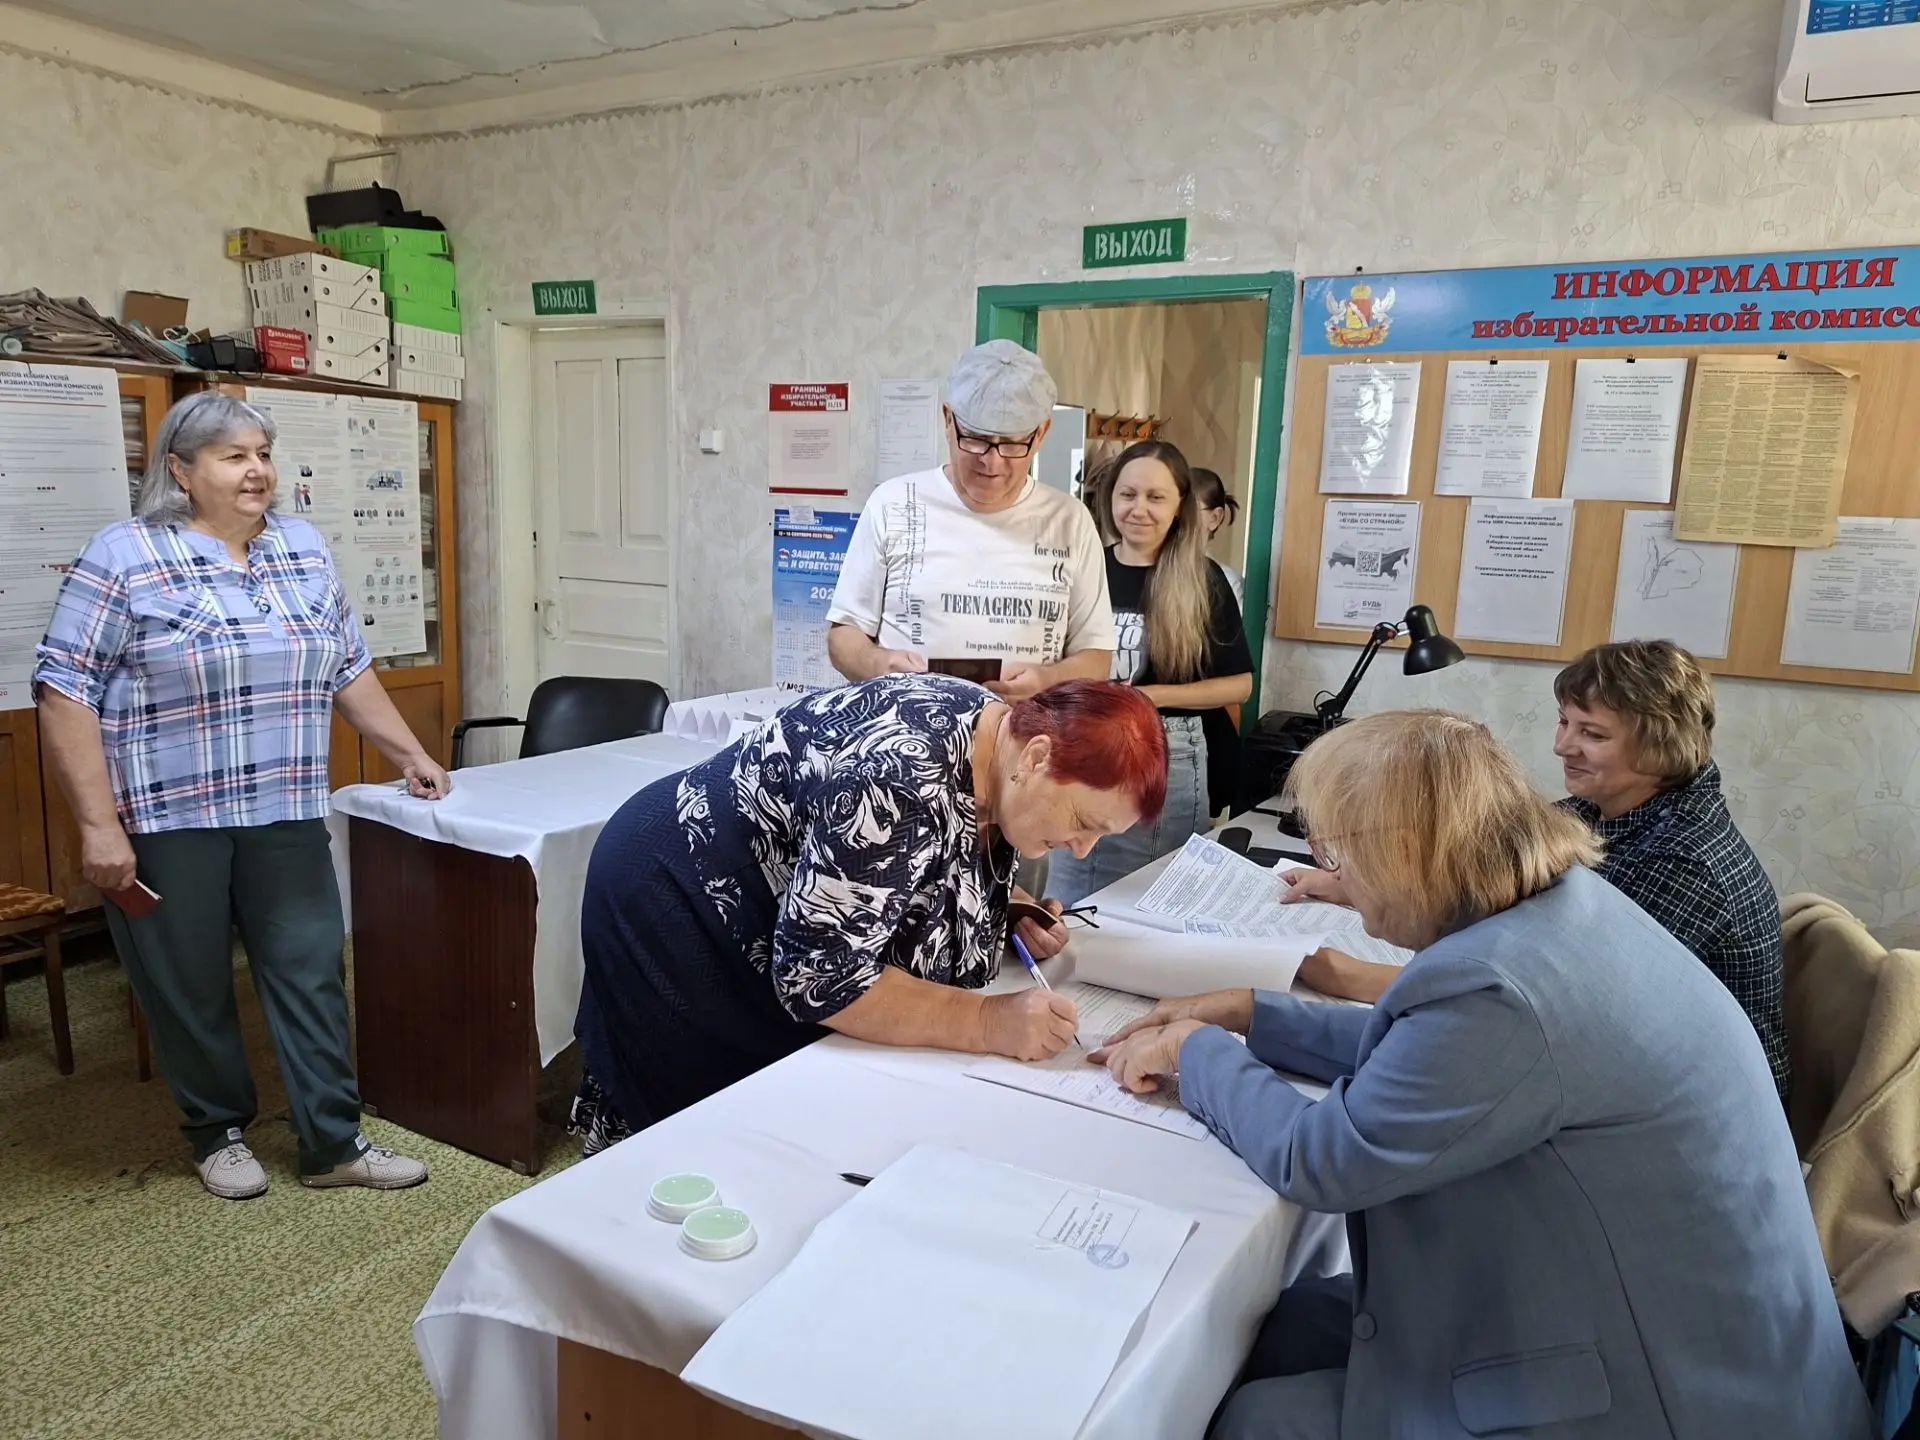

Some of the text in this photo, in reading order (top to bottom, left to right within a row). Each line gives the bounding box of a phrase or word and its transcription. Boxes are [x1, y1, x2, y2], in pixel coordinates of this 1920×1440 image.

[1095, 227, 1172, 260] ВЫХОД
[1551, 257, 1899, 300] ИНФОРМАЦИЯ
[540, 286, 588, 309] ВЫХОД
[1471, 303, 1920, 343] избирательной комисс
[4, 379, 104, 391] ИЗБИРАТЕЛЬНОЙ КОМИССИЕЙ
[790, 385, 827, 394] ГРАНИЦЫ
[791, 549, 827, 561] ЗАЩИТА,
[1034, 543, 1070, 558] for end
[791, 559, 797, 569] И
[941, 593, 1033, 618] TEENAGERS
[910, 599, 925, 645] for end
[965, 640, 1039, 655] Impossible people
